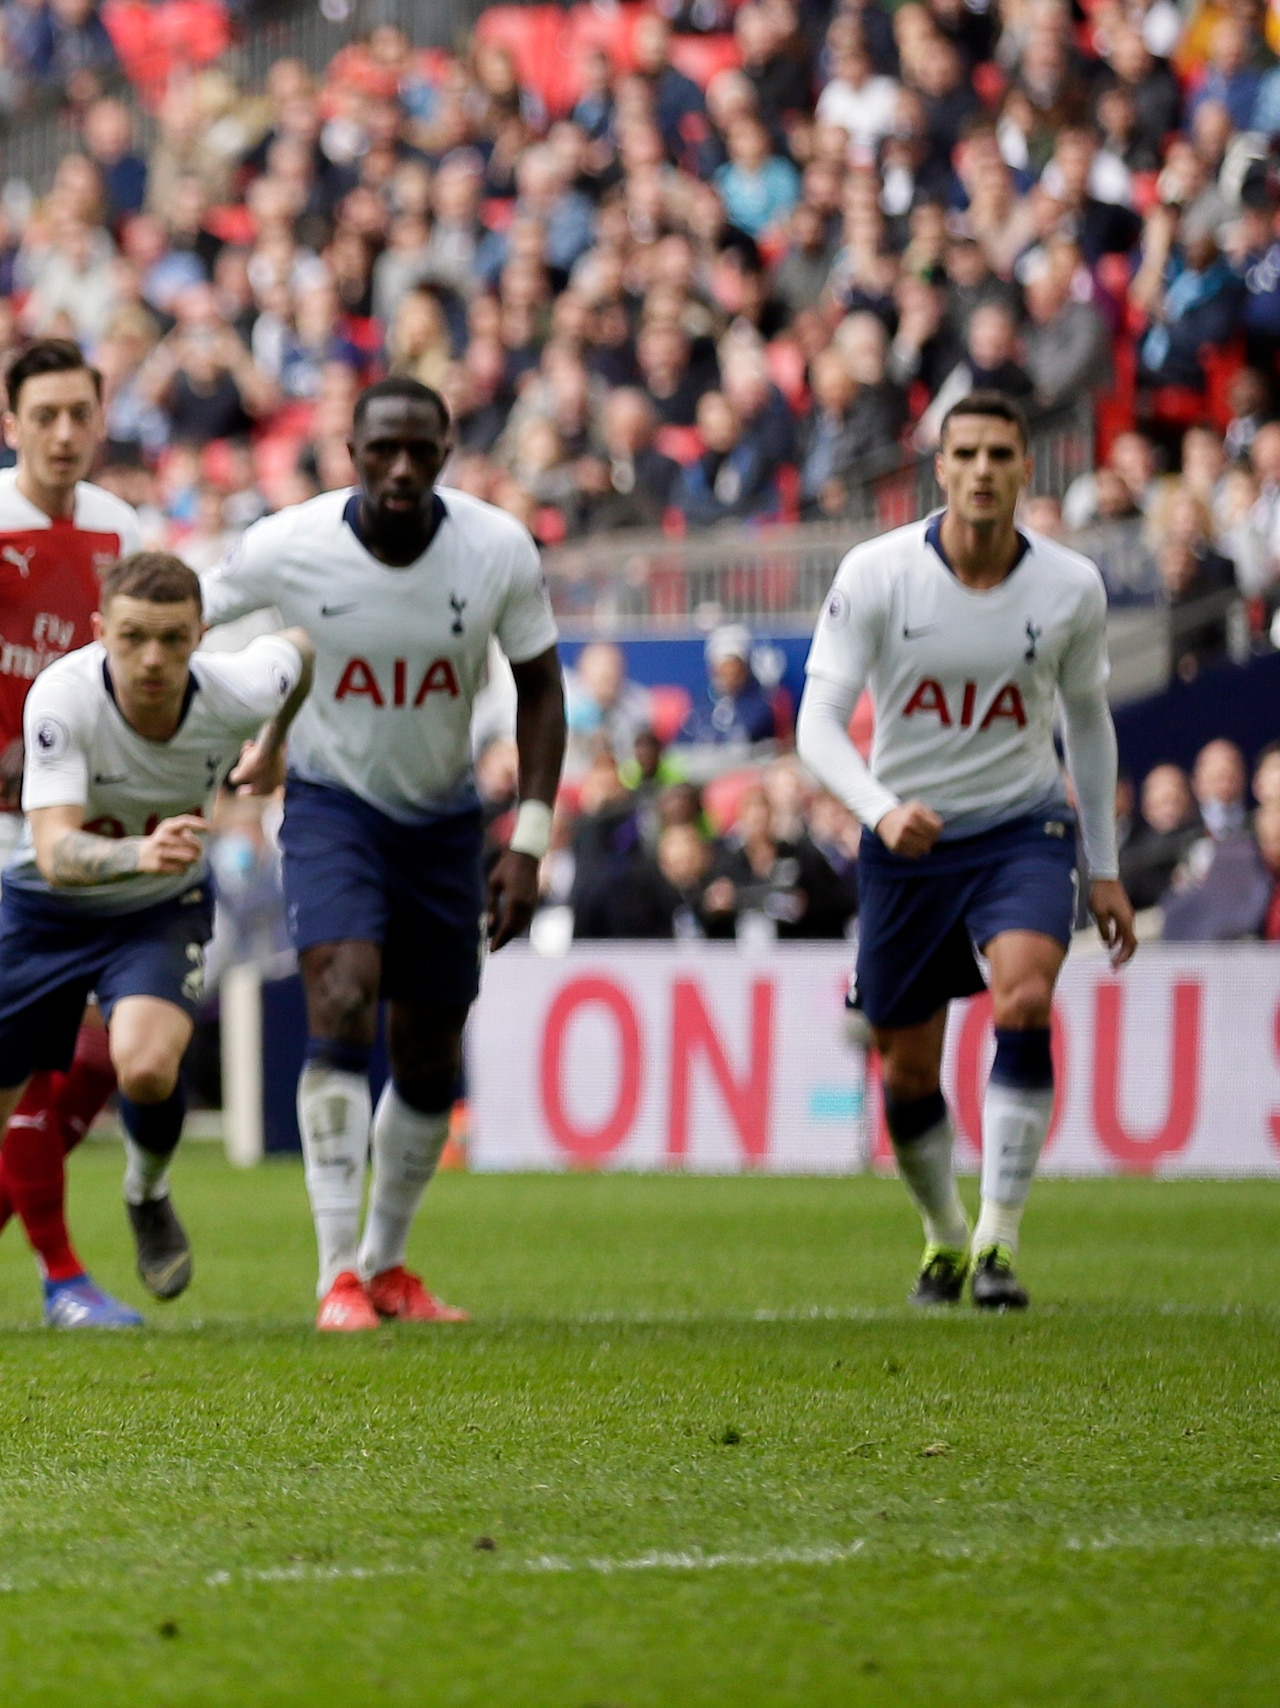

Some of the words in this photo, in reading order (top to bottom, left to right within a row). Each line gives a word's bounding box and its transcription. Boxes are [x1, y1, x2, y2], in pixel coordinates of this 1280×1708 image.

[333, 655, 461, 709] AIA
[901, 676, 1028, 731] AIA
[541, 975, 774, 1165] ON
